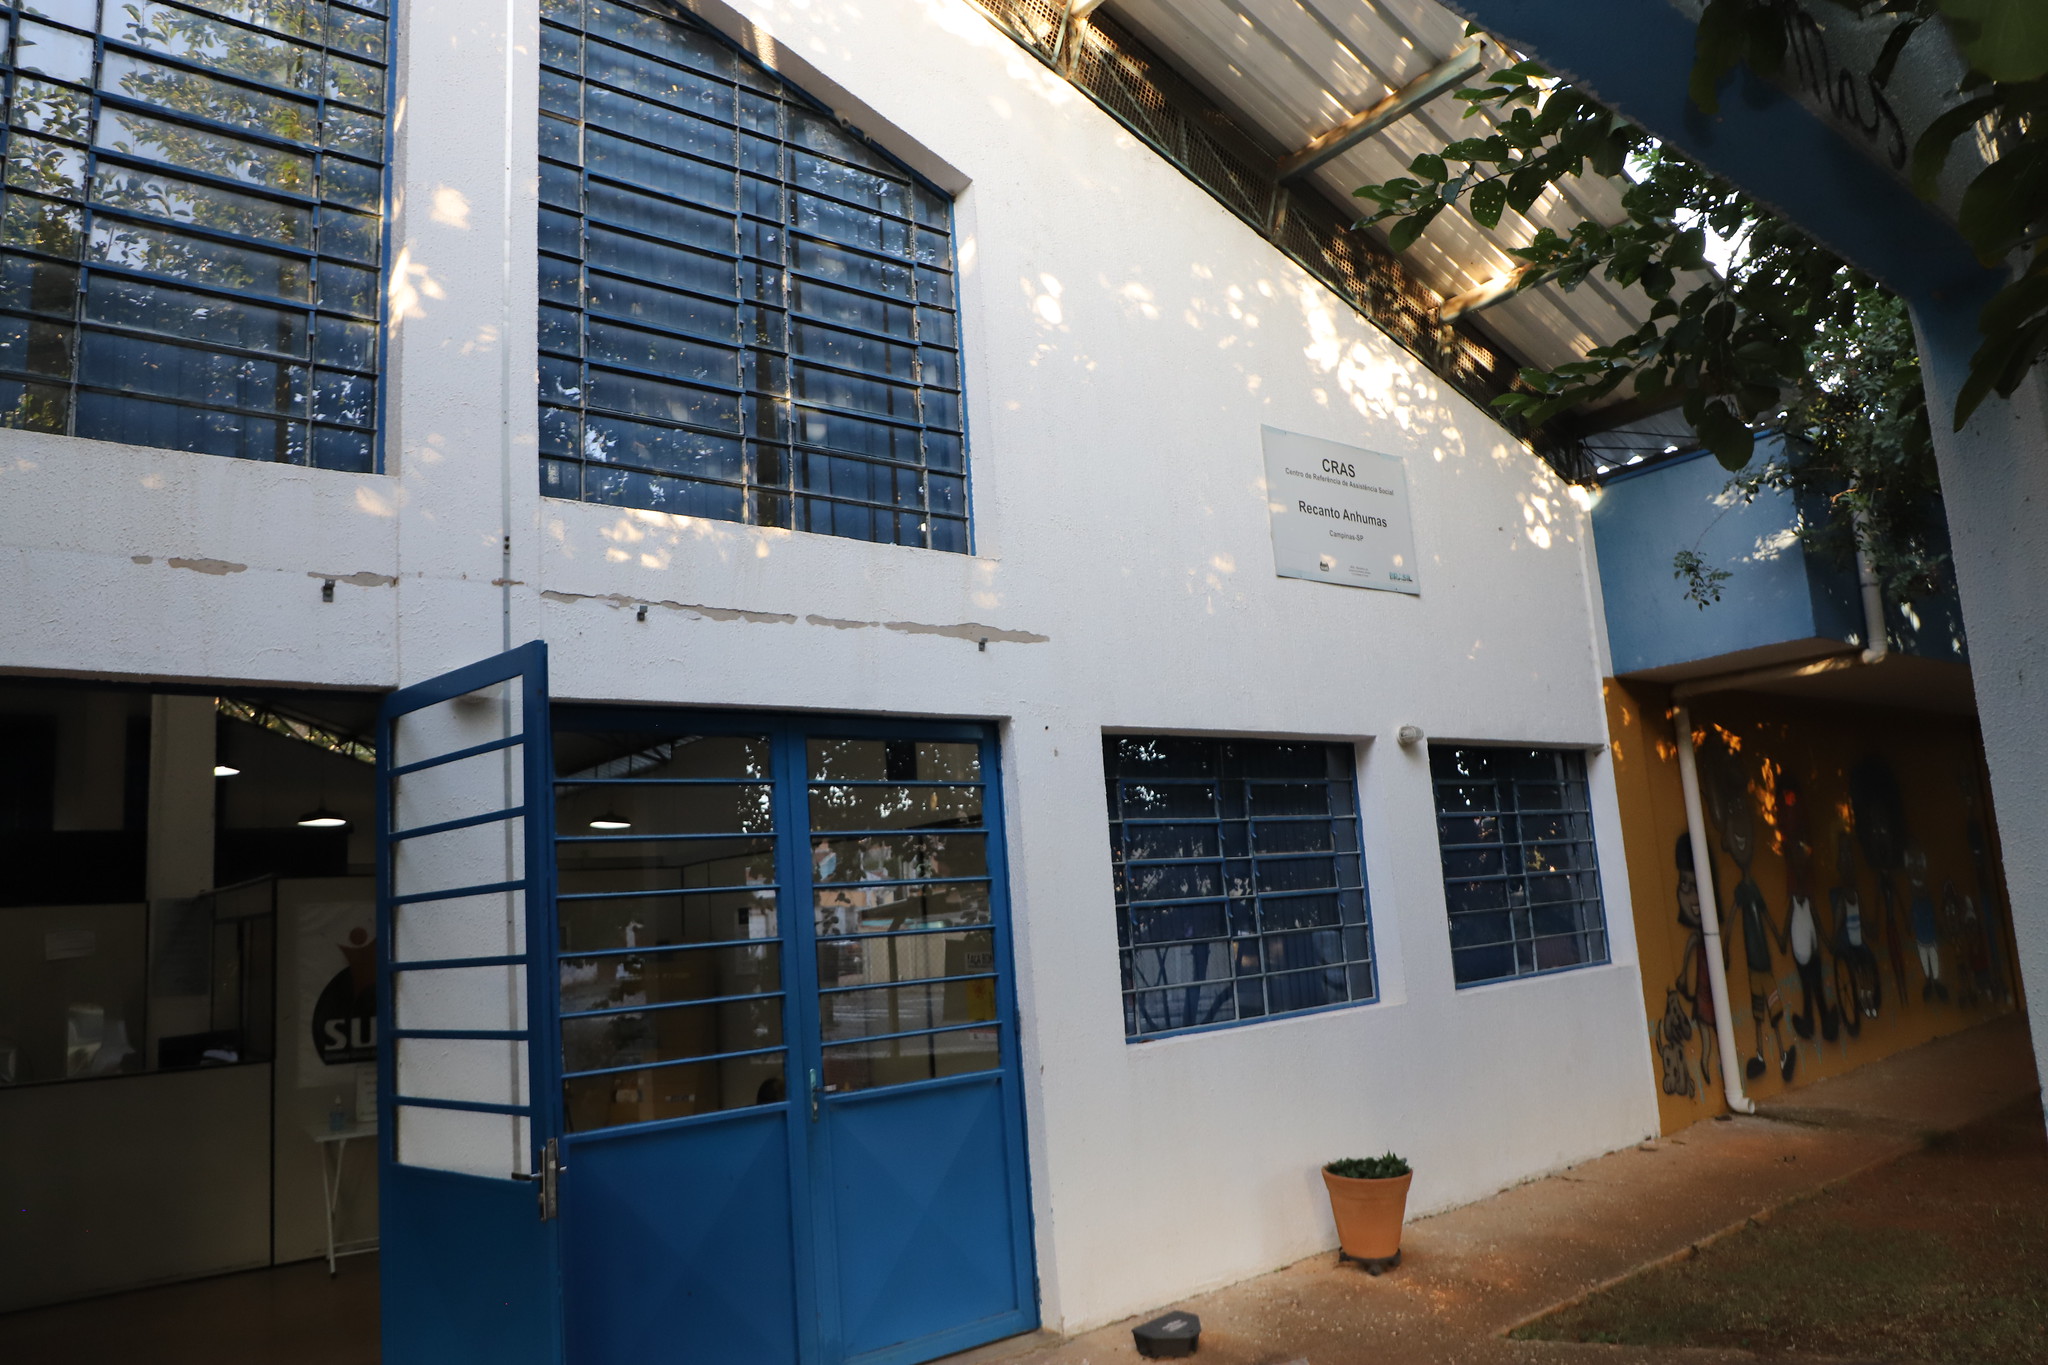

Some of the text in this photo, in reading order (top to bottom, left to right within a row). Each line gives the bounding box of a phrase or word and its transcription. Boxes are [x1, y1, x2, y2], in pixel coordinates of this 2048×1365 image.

[1285, 467, 1304, 477] Centro
[1312, 473, 1341, 485] Referência
[1349, 481, 1378, 493] Assistência
[1378, 487, 1394, 496] Social
[1322, 458, 1356, 478] CRAS
[1298, 500, 1388, 528] Recanto Anhumas
